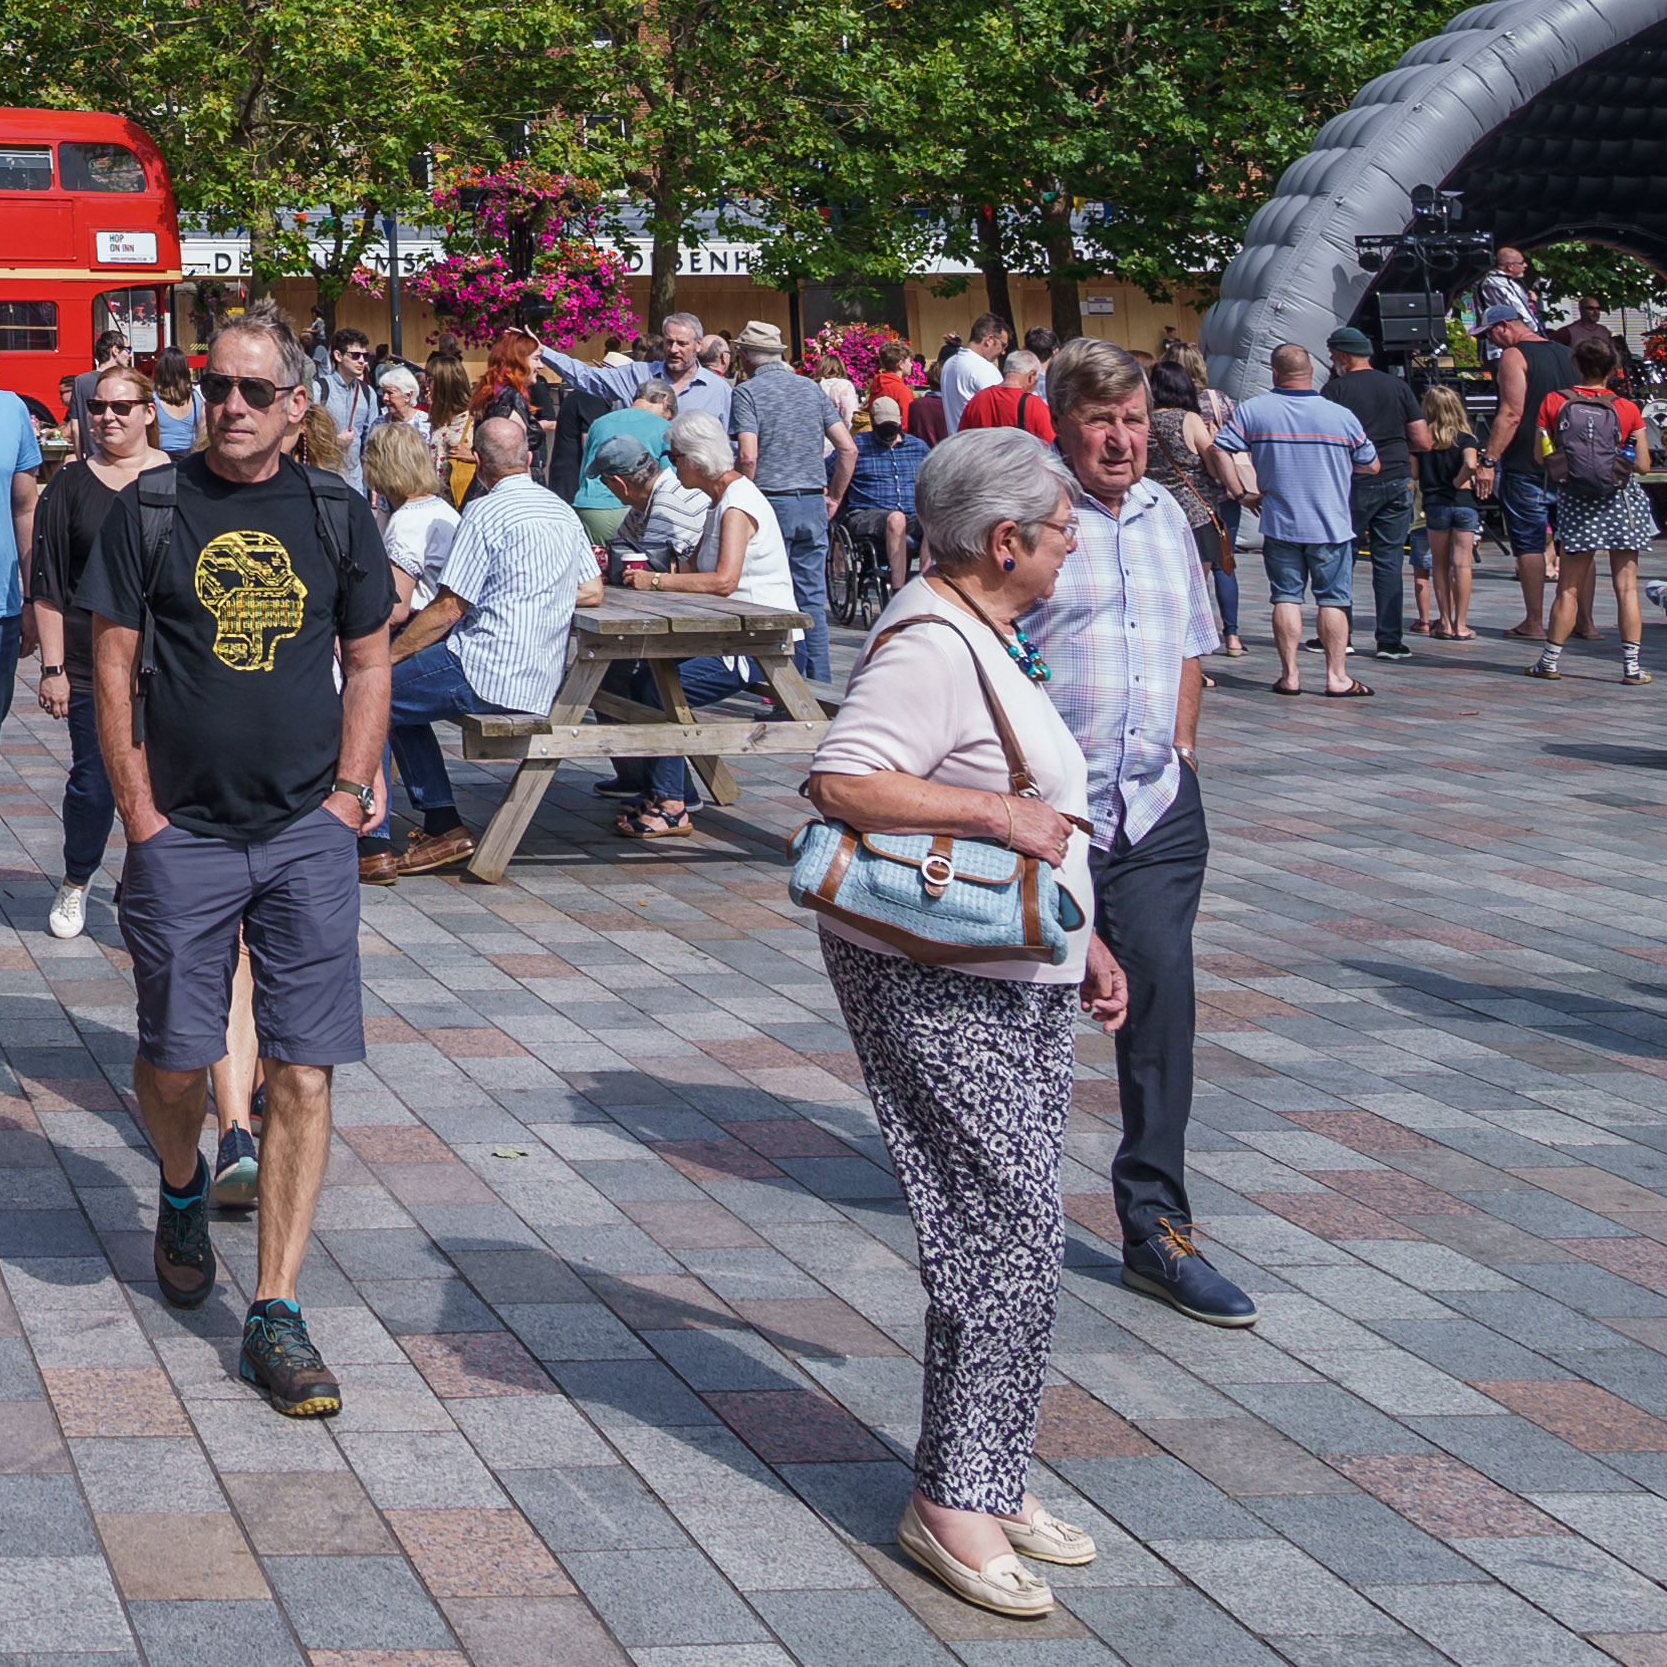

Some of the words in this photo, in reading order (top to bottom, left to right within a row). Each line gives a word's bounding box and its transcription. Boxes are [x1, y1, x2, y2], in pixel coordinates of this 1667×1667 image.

[109, 234, 124, 243] HOP
[110, 243, 120, 252] ON
[122, 243, 134, 252] INN
[626, 251, 752, 274] DBENH
